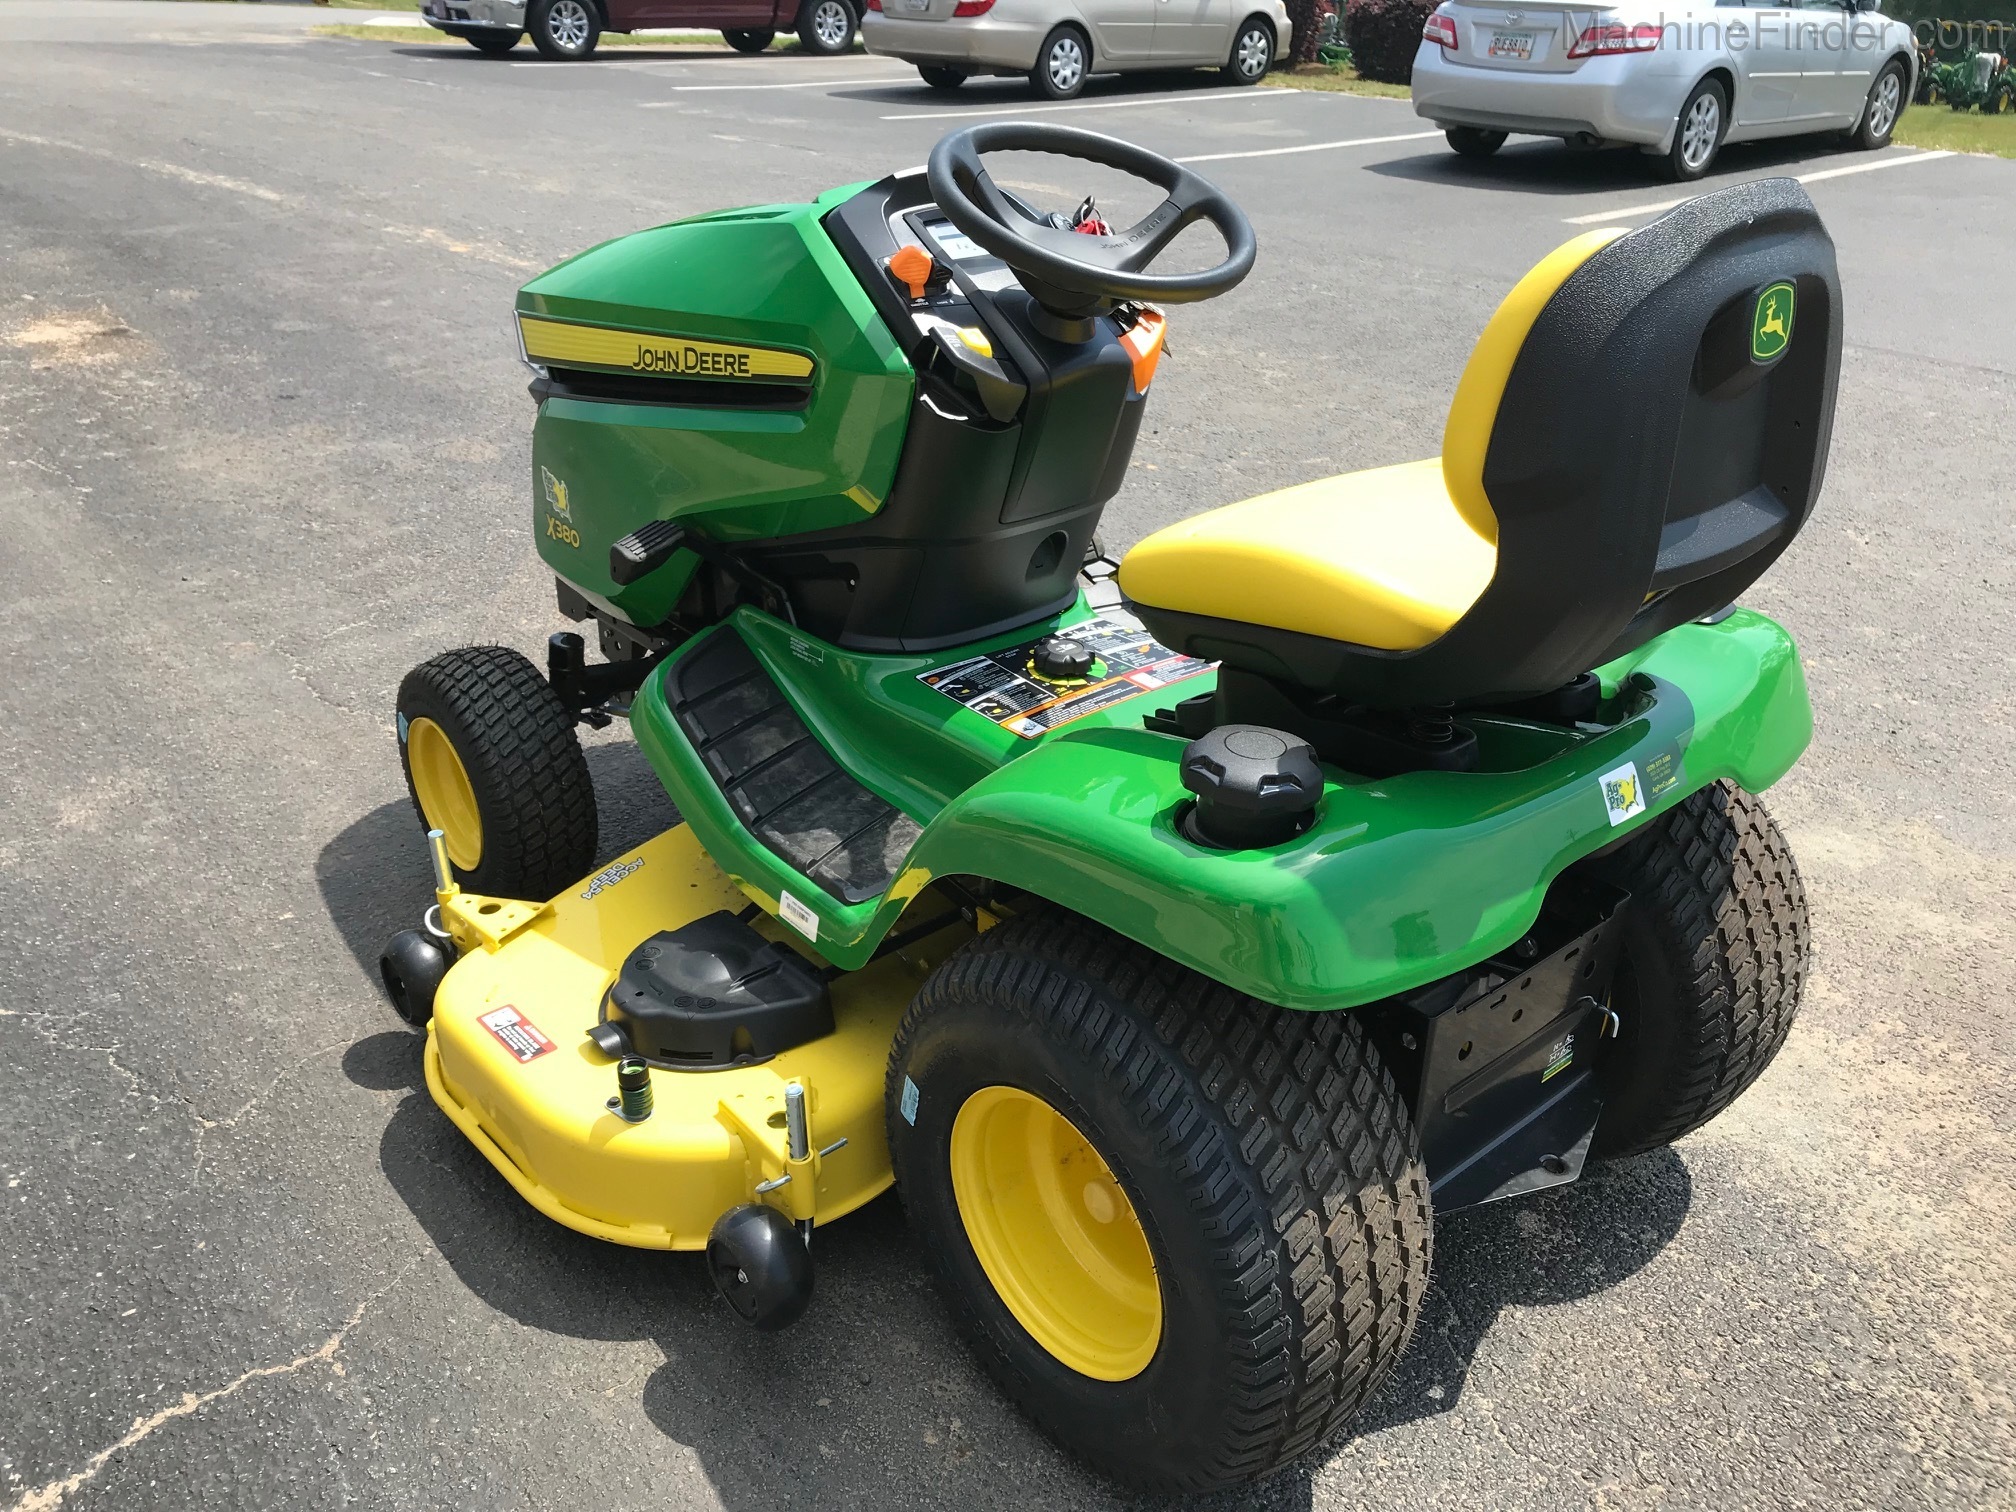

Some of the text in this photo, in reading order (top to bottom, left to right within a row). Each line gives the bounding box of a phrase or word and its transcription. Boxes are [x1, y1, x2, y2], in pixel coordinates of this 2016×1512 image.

[546, 513, 580, 548] X380
[590, 862, 626, 889] DEEP
[600, 857, 645, 887] ACCEL
